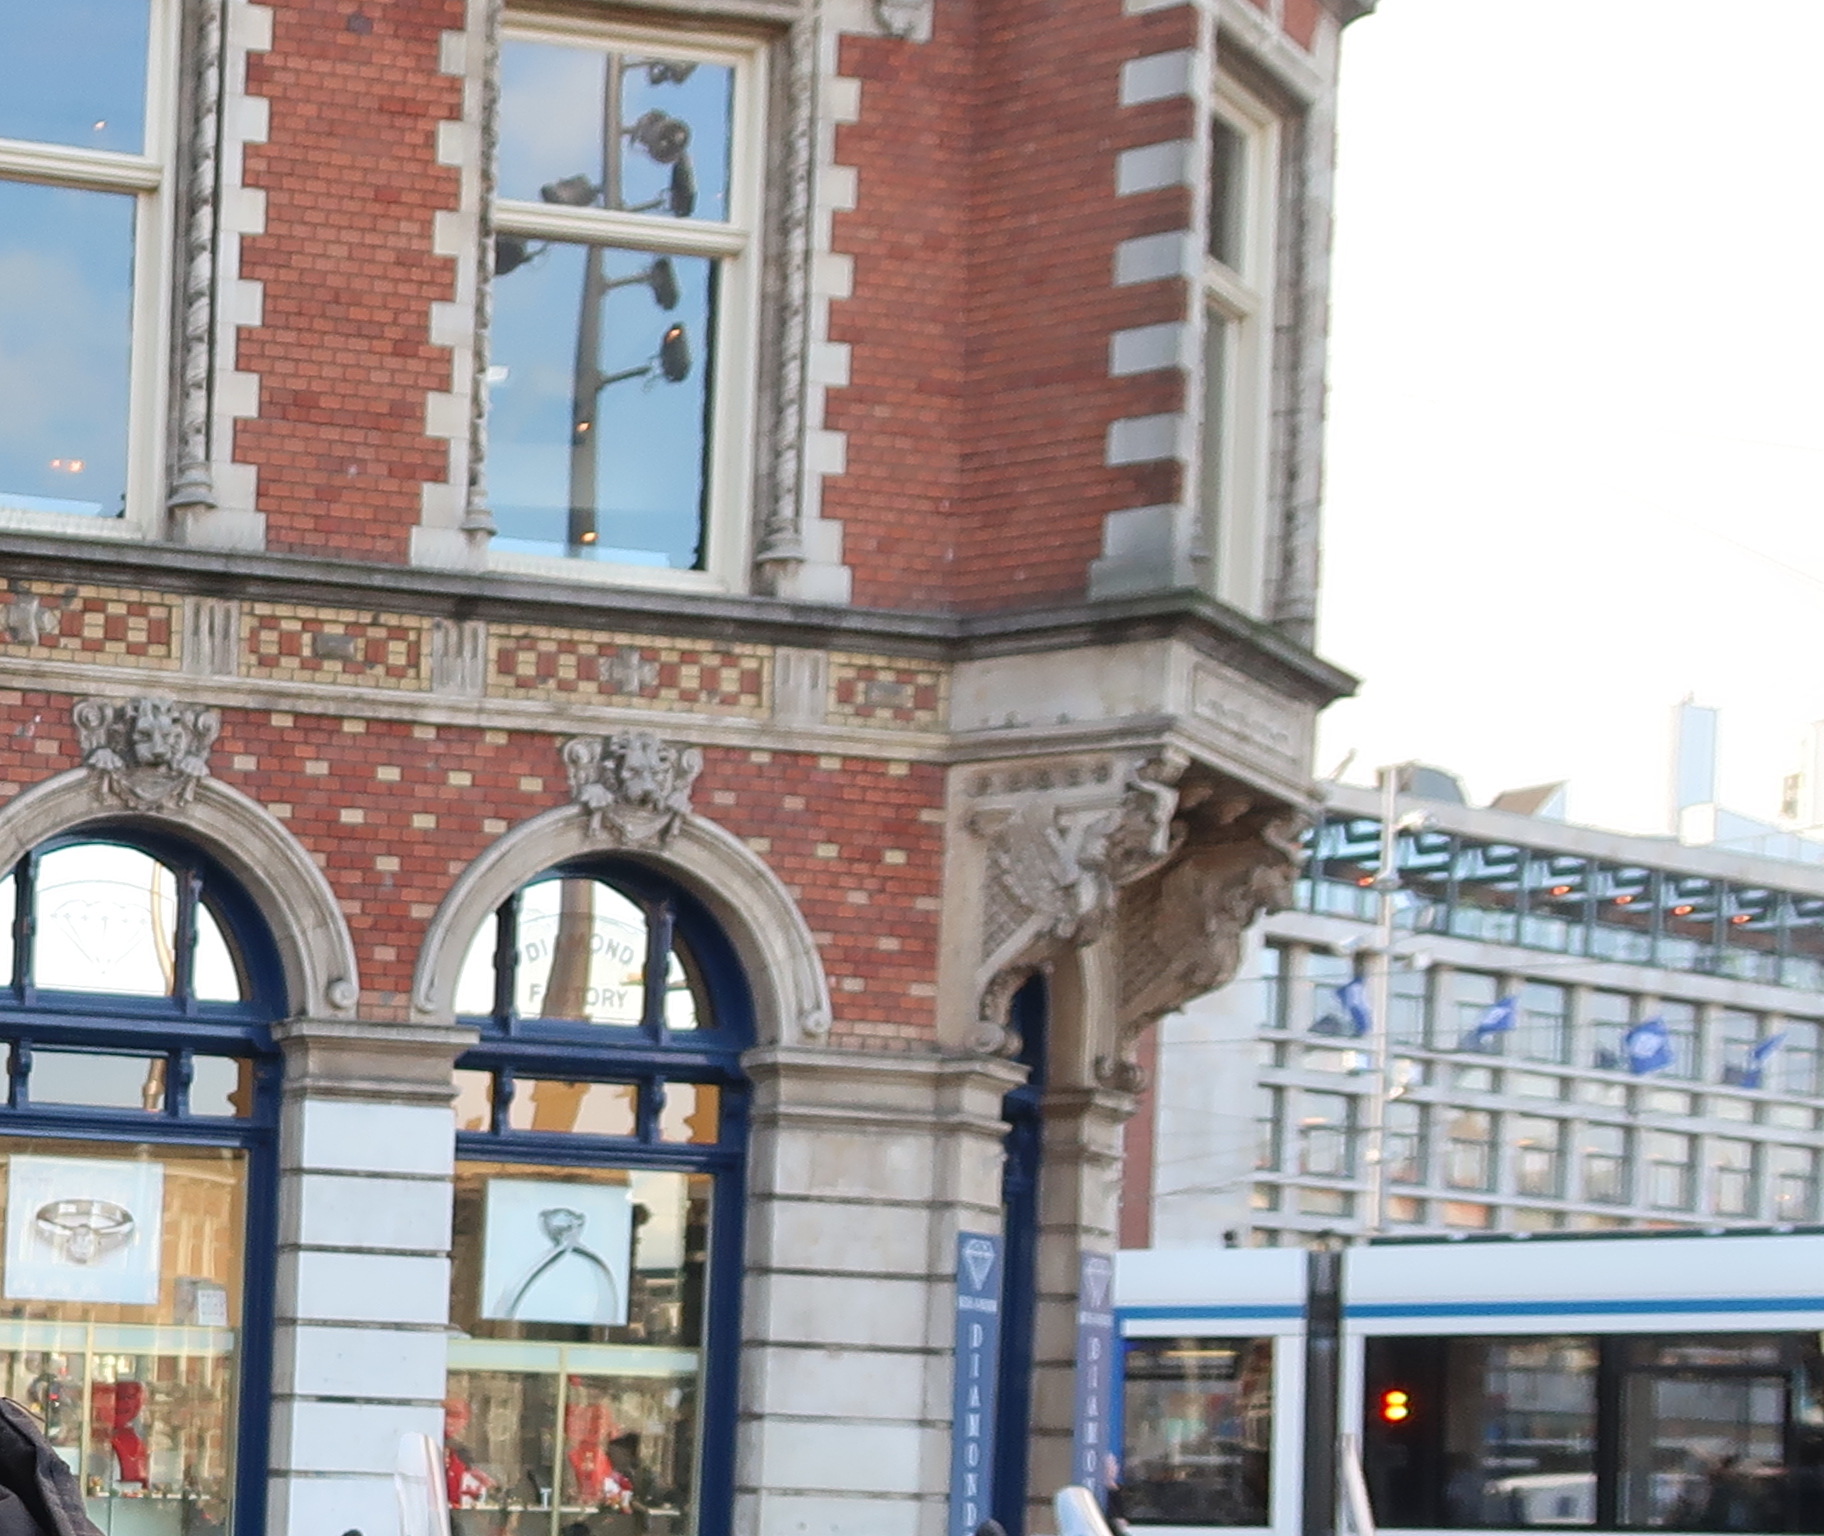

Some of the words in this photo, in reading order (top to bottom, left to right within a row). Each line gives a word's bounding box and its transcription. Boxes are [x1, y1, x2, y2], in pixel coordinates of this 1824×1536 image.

[526, 932, 635, 965] DIOND
[529, 984, 629, 1008] FORY
[1081, 1336, 1102, 1491] DIAMO
